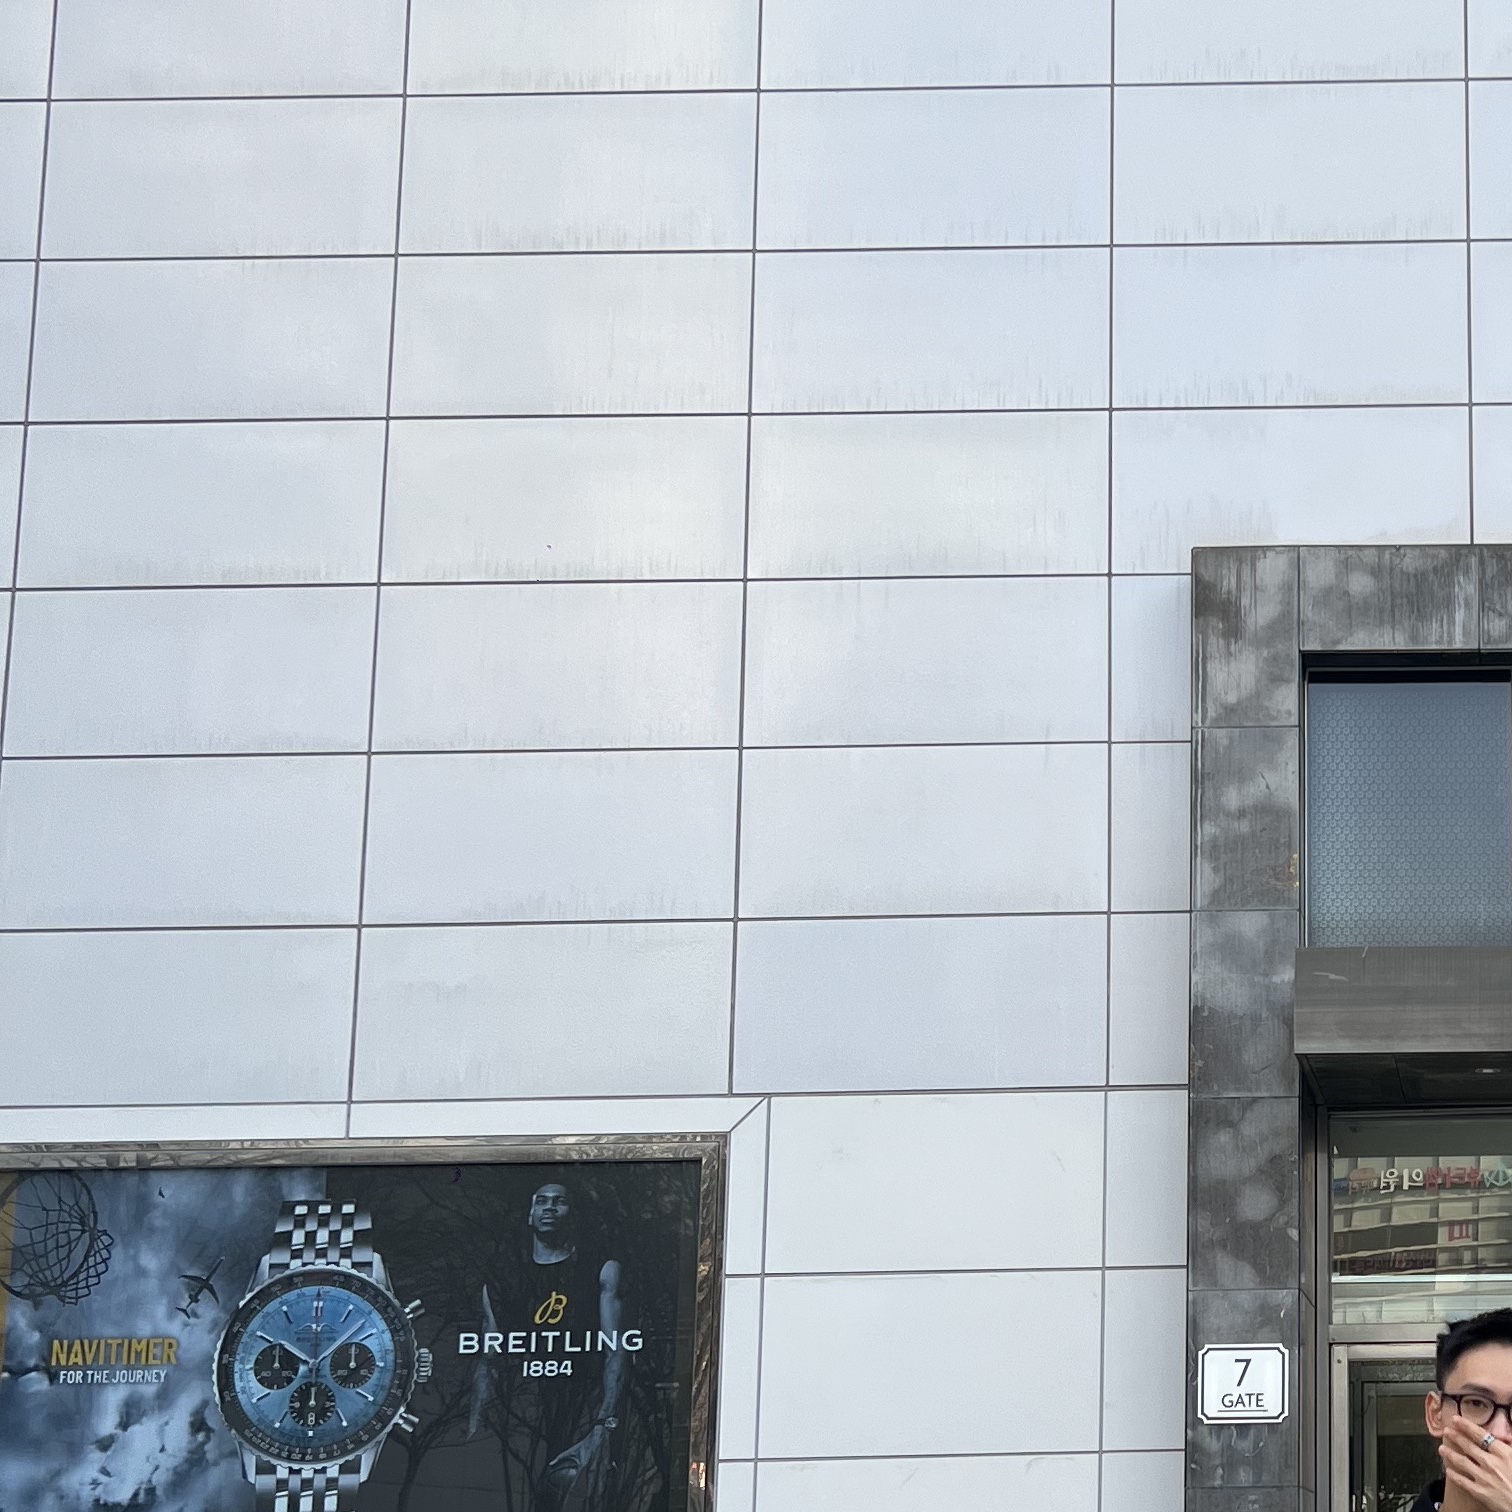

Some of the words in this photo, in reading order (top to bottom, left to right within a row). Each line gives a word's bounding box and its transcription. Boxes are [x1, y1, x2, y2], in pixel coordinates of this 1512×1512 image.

[51, 1338, 178, 1366] NAVITIMER
[458, 1330, 644, 1354] BREITLING
[60, 1370, 84, 1384] FOR
[86, 1370, 110, 1383] THE
[112, 1369, 168, 1383] JOURNEY
[522, 1360, 573, 1377] 1884
[1234, 1358, 1252, 1387] 7
[1221, 1393, 1265, 1408] GATE
